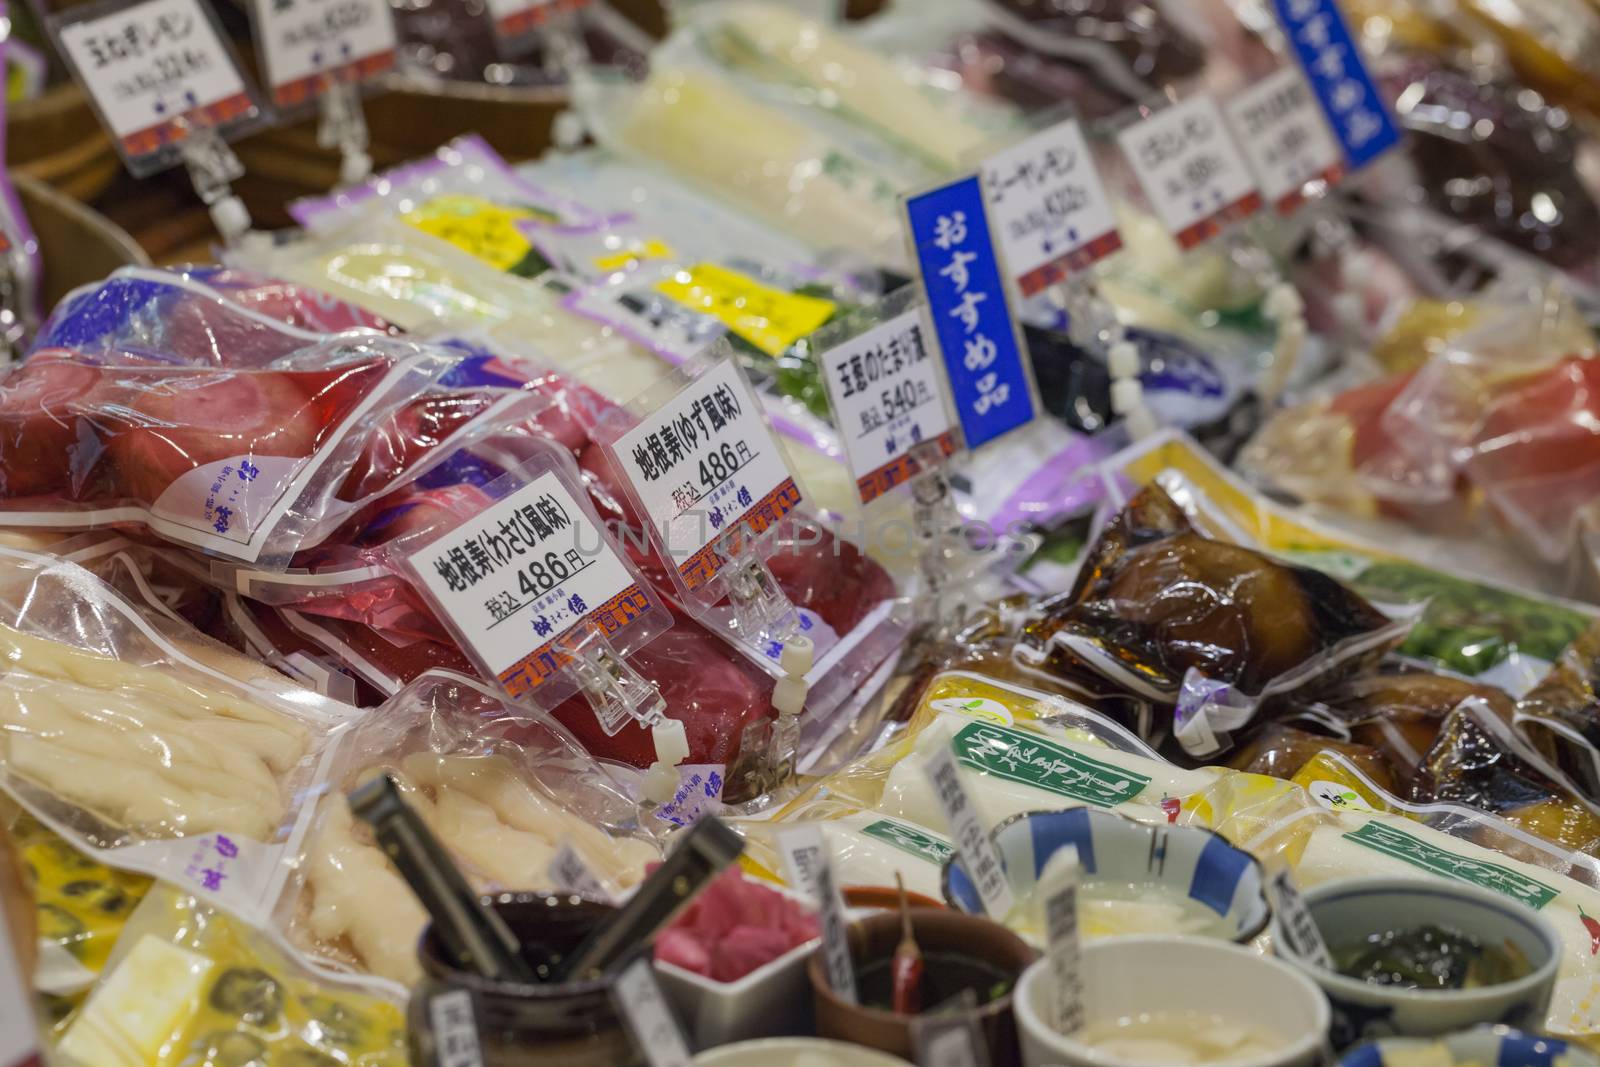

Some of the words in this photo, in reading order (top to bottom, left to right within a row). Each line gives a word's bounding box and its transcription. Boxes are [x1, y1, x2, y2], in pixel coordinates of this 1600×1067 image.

[933, 210, 1010, 415] おすすめ品
[517, 548, 586, 598] 486円
